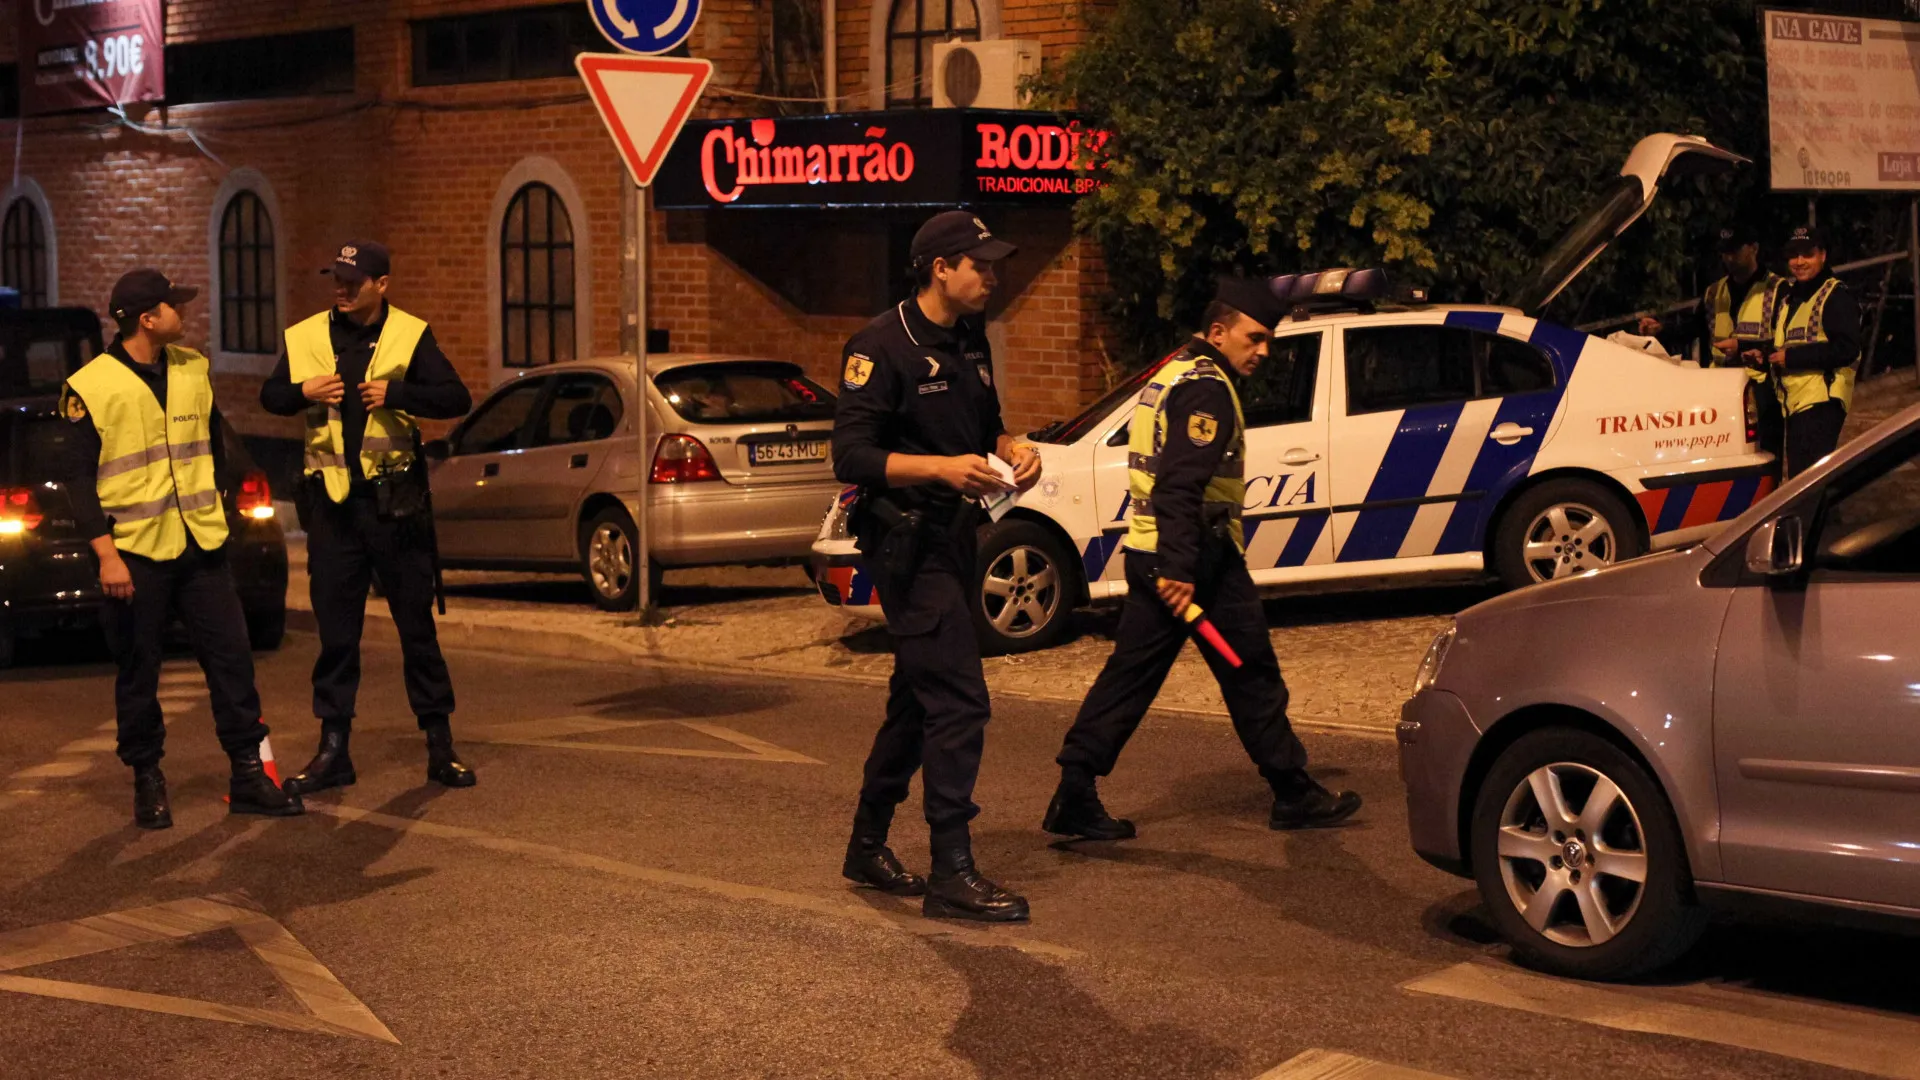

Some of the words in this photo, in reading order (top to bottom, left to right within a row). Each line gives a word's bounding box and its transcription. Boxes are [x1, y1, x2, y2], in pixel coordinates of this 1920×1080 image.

[1776, 17, 1801, 38] NA
[1808, 20, 1859, 42] CAVE:
[701, 119, 914, 203] Chimarrão
[1883, 156, 1911, 178] Loja
[976, 176, 1072, 194] TRADICIONAL
[1654, 432, 1731, 449] www.psp.pt
